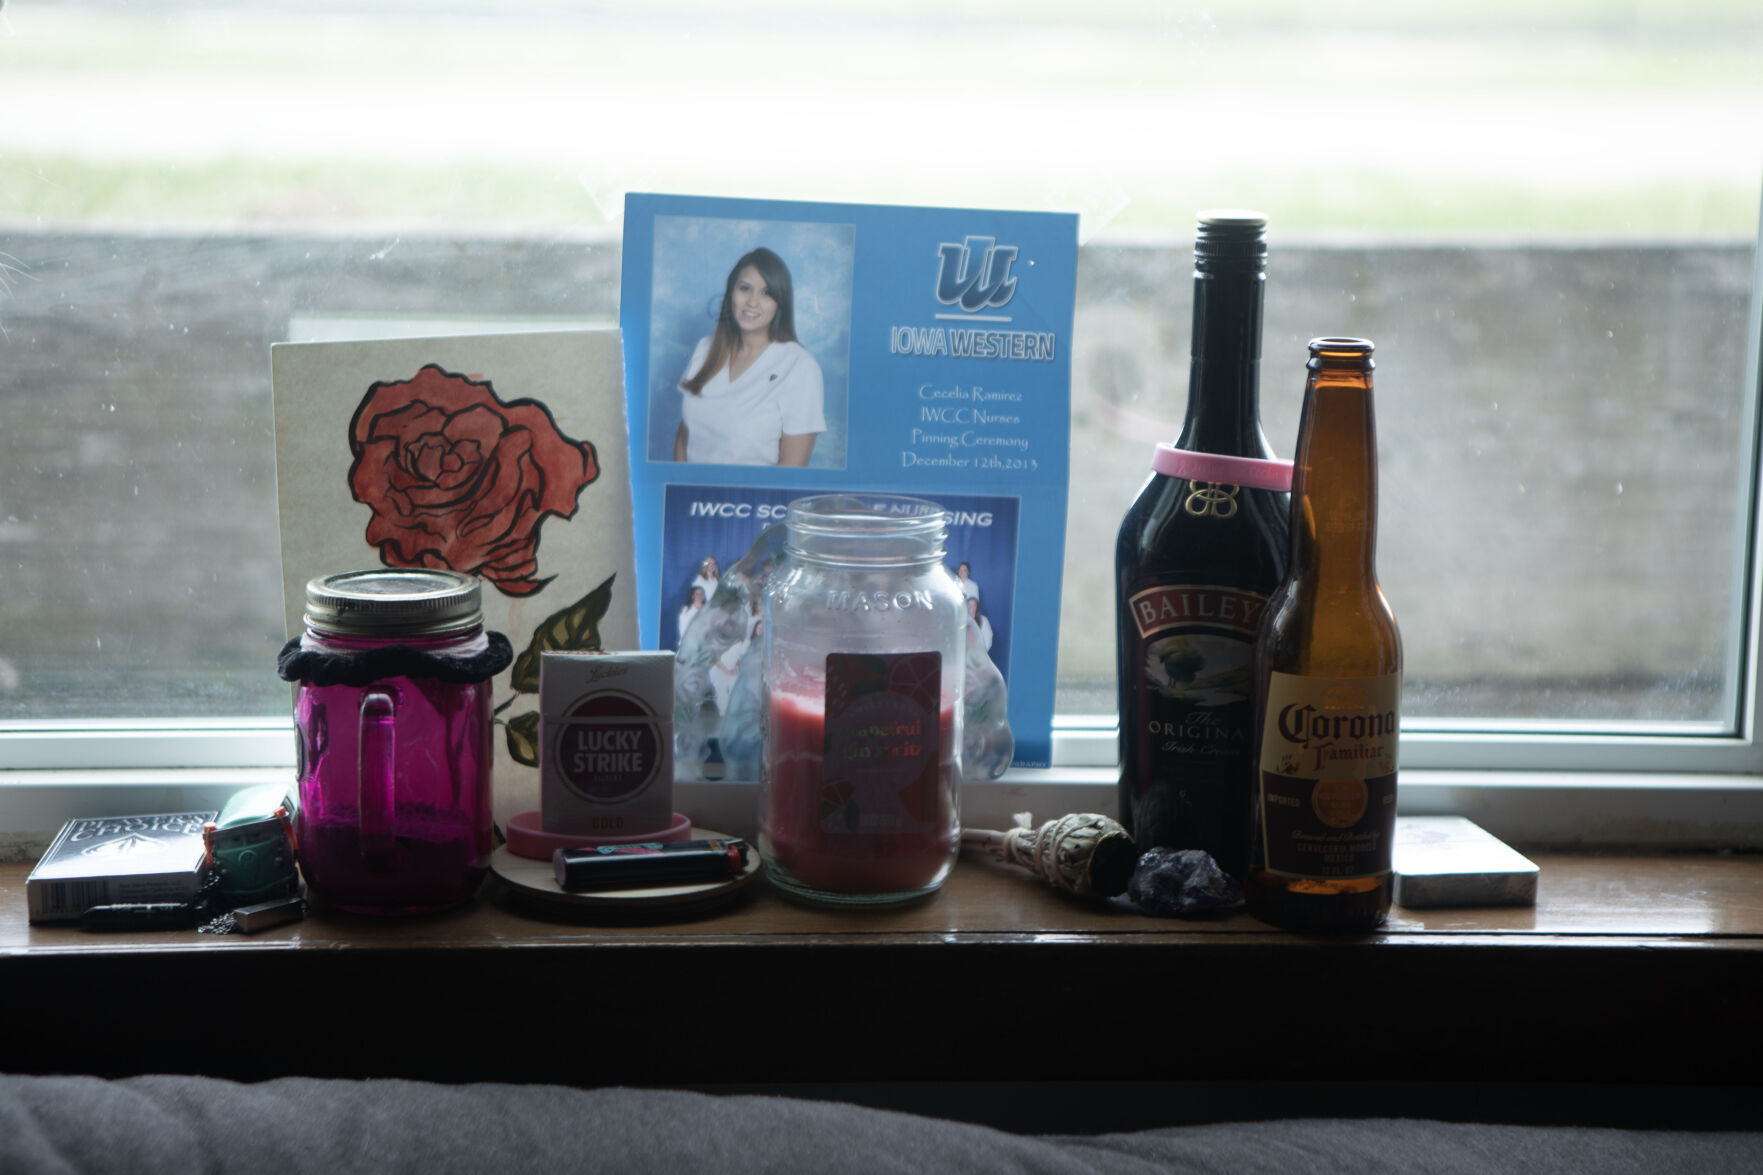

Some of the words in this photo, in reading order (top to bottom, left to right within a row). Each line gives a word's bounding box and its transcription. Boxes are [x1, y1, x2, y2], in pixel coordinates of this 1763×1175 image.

[891, 326, 947, 357] IOWA
[949, 329, 1055, 360] WESTERN
[919, 384, 969, 401] Cecelia
[972, 386, 1023, 402] Ramirez
[920, 407, 970, 424] IWCC
[973, 409, 1020, 424] Nurses
[912, 429, 958, 448] Pinning
[961, 431, 1029, 450] Ceremony
[902, 451, 970, 468] December
[690, 502, 752, 517] IWCC
[826, 588, 936, 612] MASON
[1138, 593, 1263, 625] BAILEY
[1185, 711, 1223, 726] The
[1278, 703, 1395, 749] Corona
[577, 730, 642, 750] LUCKY
[1148, 720, 1245, 740] ORIGINA
[573, 753, 643, 773] STRIKE
[1311, 742, 1385, 771] Familiar
[71, 823, 201, 842] CHOICE
